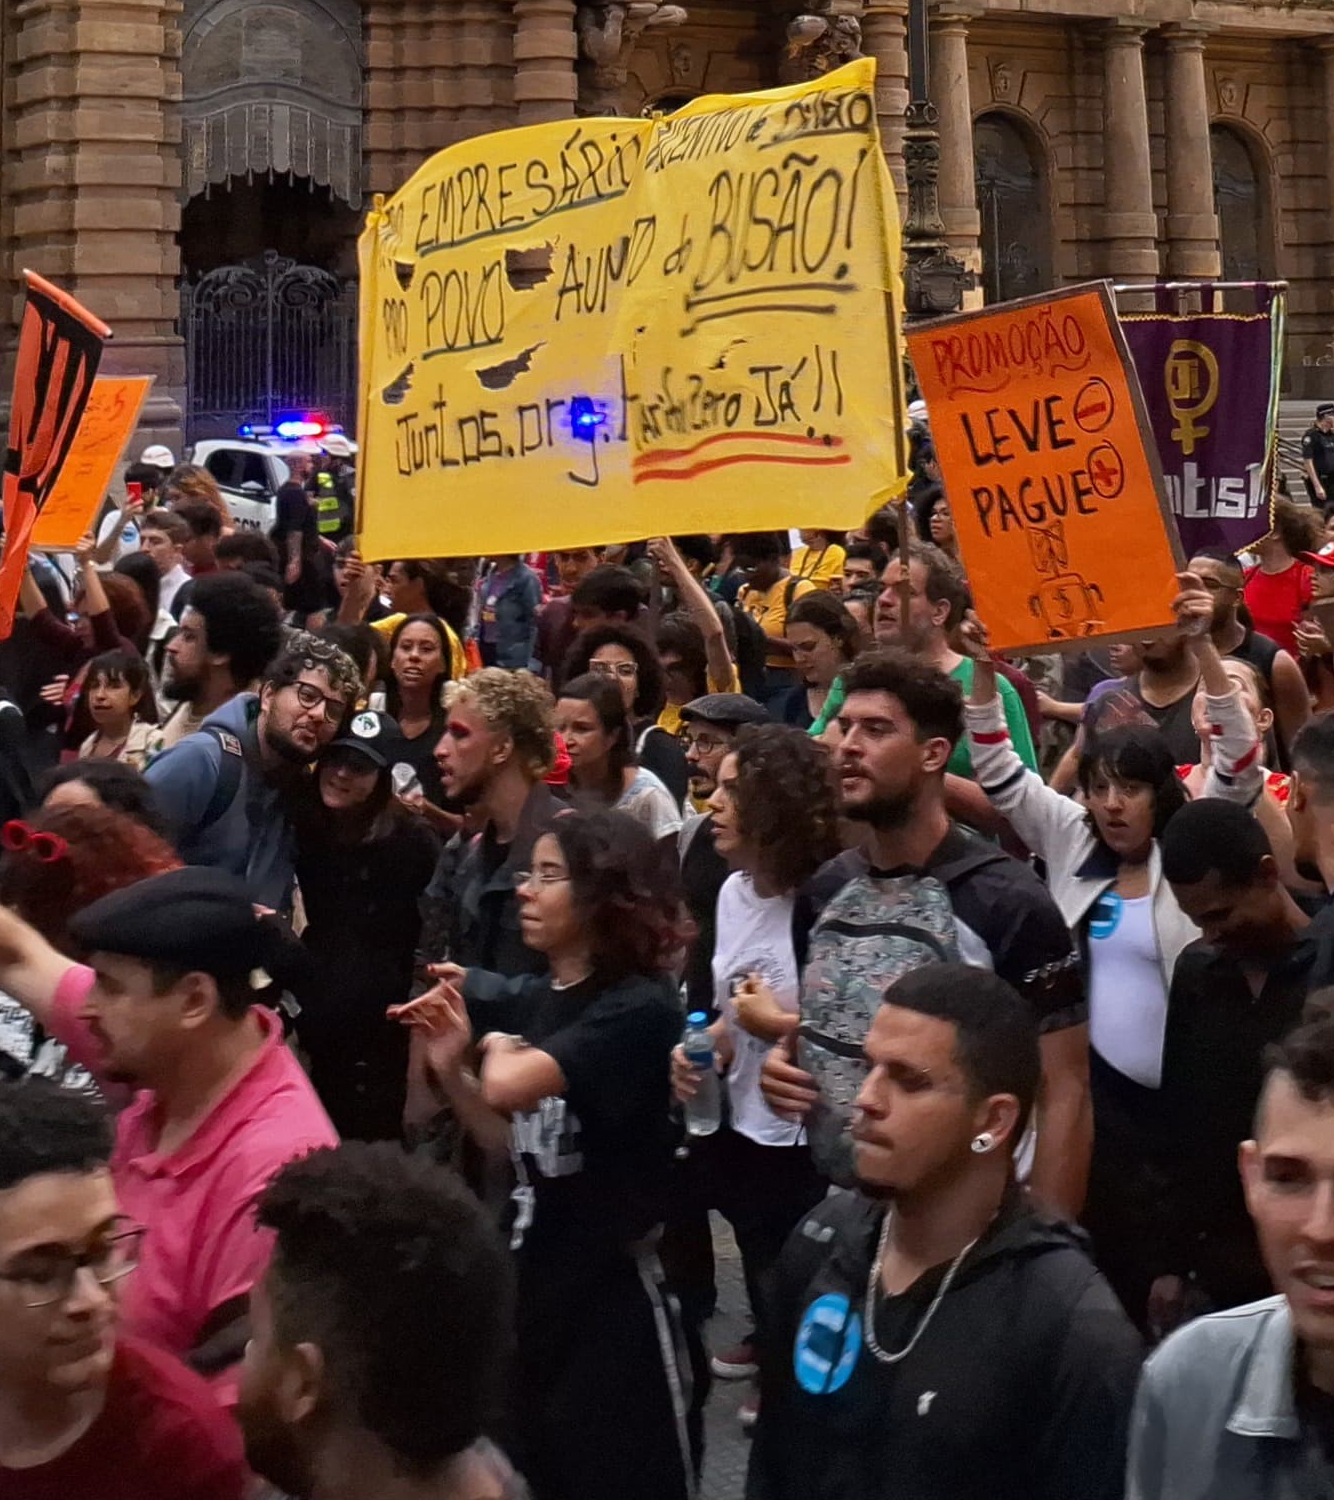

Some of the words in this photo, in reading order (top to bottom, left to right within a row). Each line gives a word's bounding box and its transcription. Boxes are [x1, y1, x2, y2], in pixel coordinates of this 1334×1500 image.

[420, 261, 505, 350] POVO
[693, 148, 869, 293] BUSÃO!
[931, 305, 1087, 388] PROMOÇÃO
[960, 395, 1076, 467] LEVE
[971, 467, 1100, 538] PAGUE
